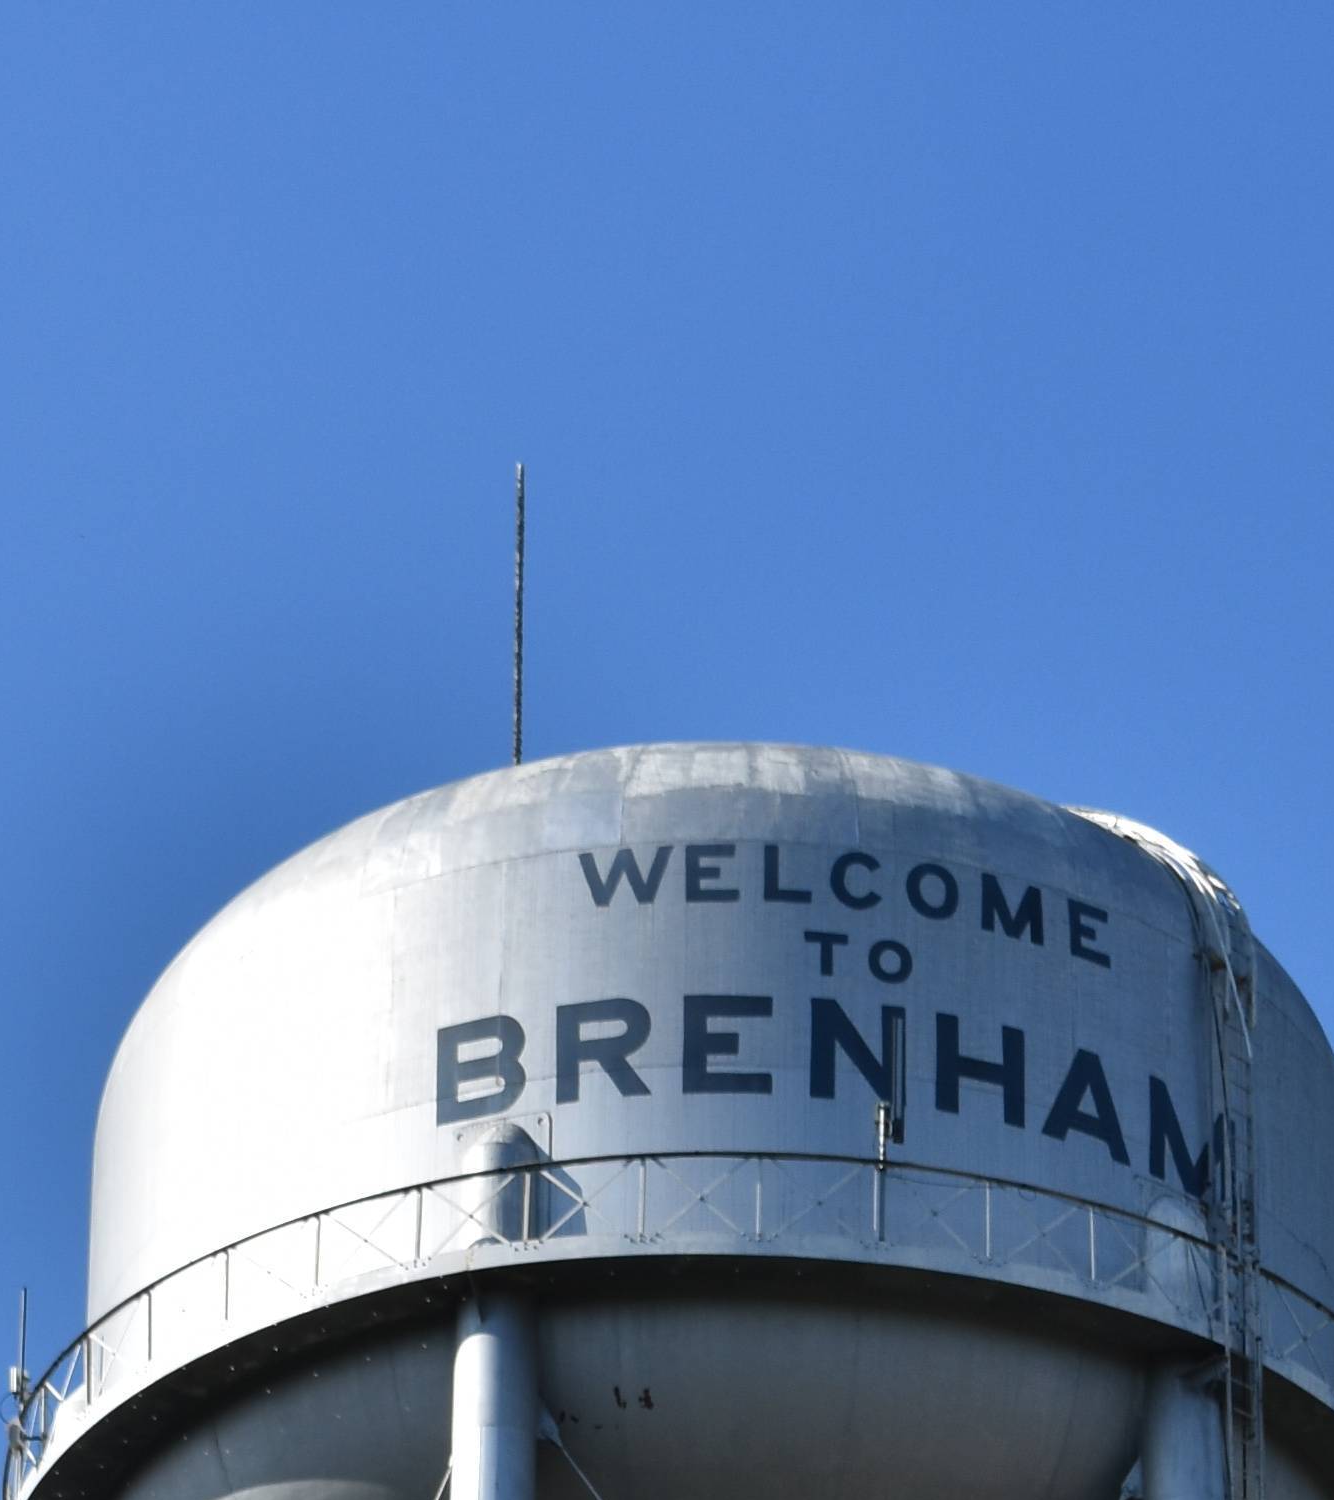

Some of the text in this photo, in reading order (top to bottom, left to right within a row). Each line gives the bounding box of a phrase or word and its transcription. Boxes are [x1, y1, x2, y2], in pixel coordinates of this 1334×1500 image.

[578, 844, 1111, 967] WELCOME
[804, 931, 913, 984] TO
[435, 994, 1235, 1210] BRENHAM
